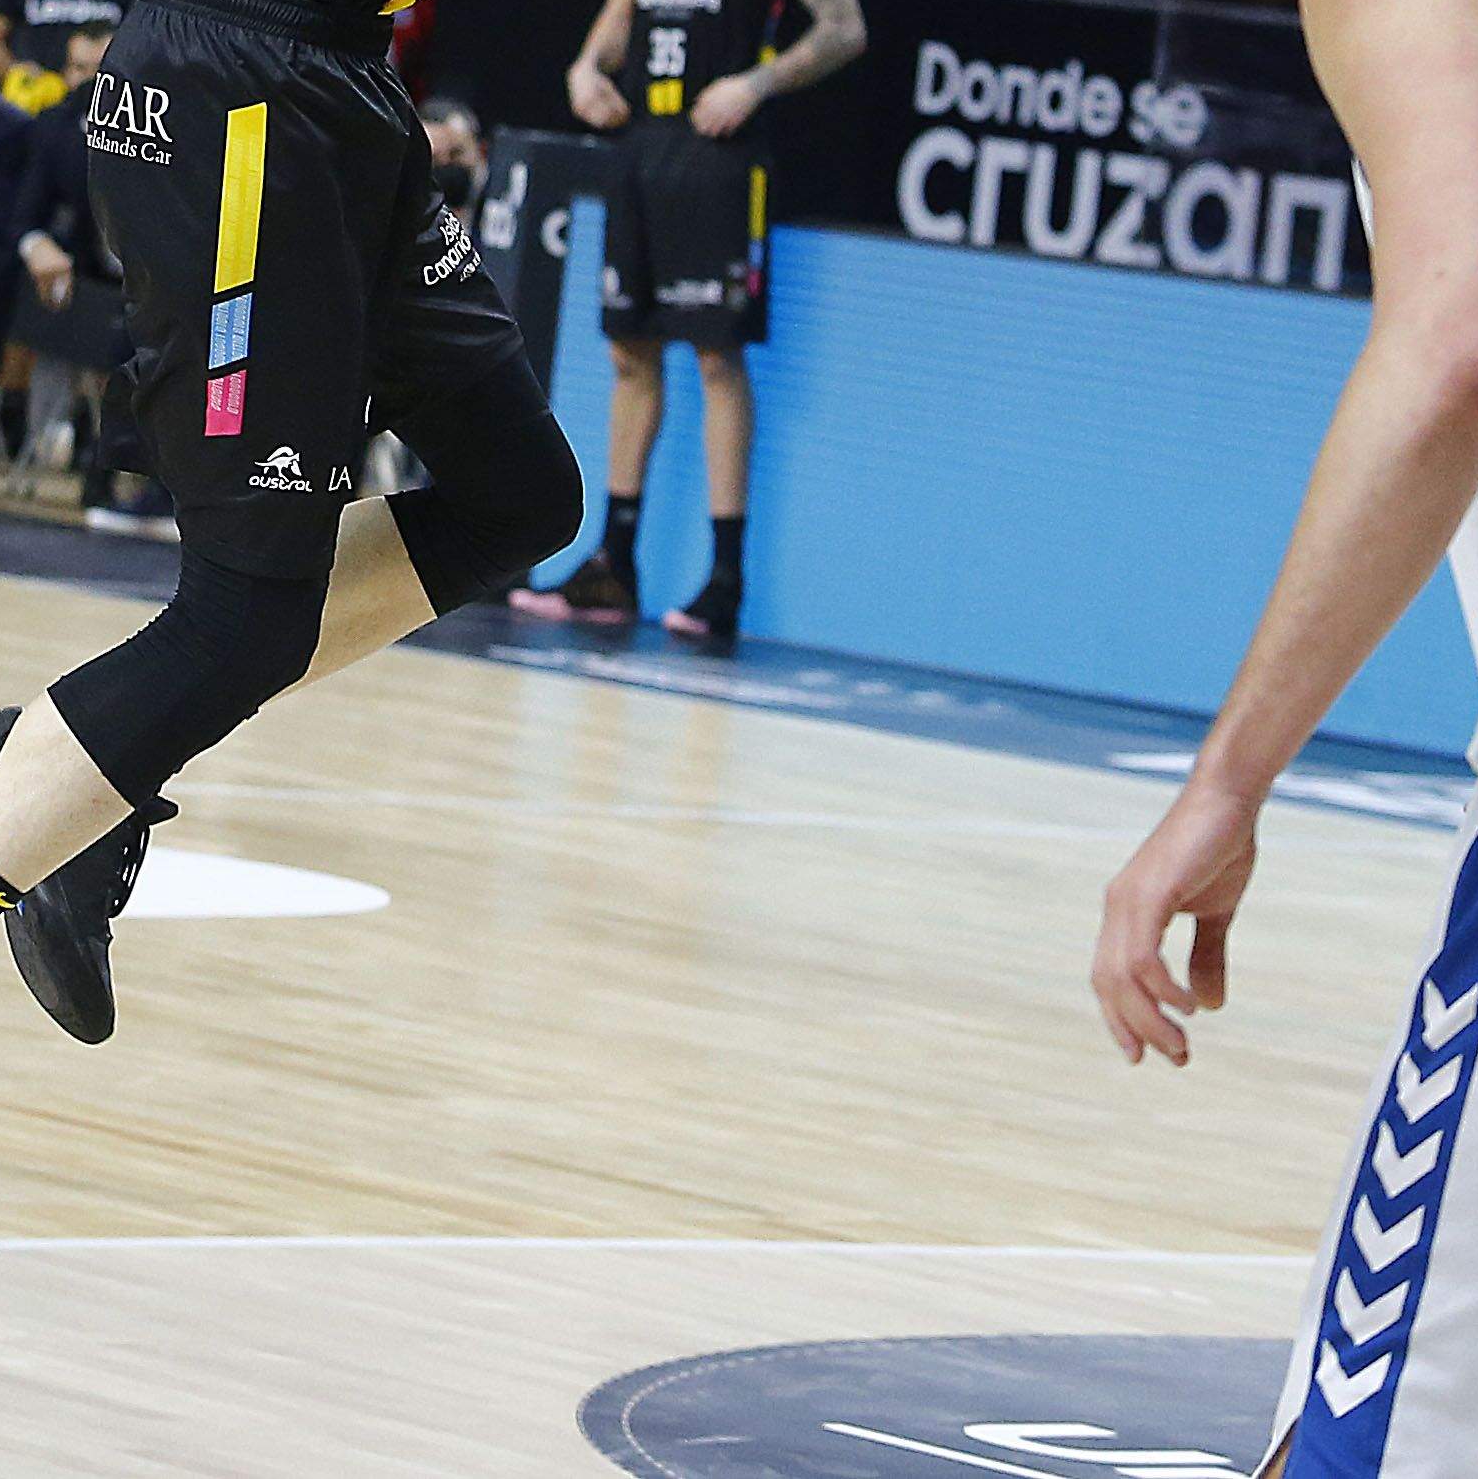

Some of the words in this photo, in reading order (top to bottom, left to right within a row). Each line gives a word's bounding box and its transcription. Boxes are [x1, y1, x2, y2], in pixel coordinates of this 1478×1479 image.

[913, 39, 1123, 137] Donde
[1129, 77, 1209, 151] se
[141, 142, 172, 165] Car
[896, 126, 1354, 292] cruzan
